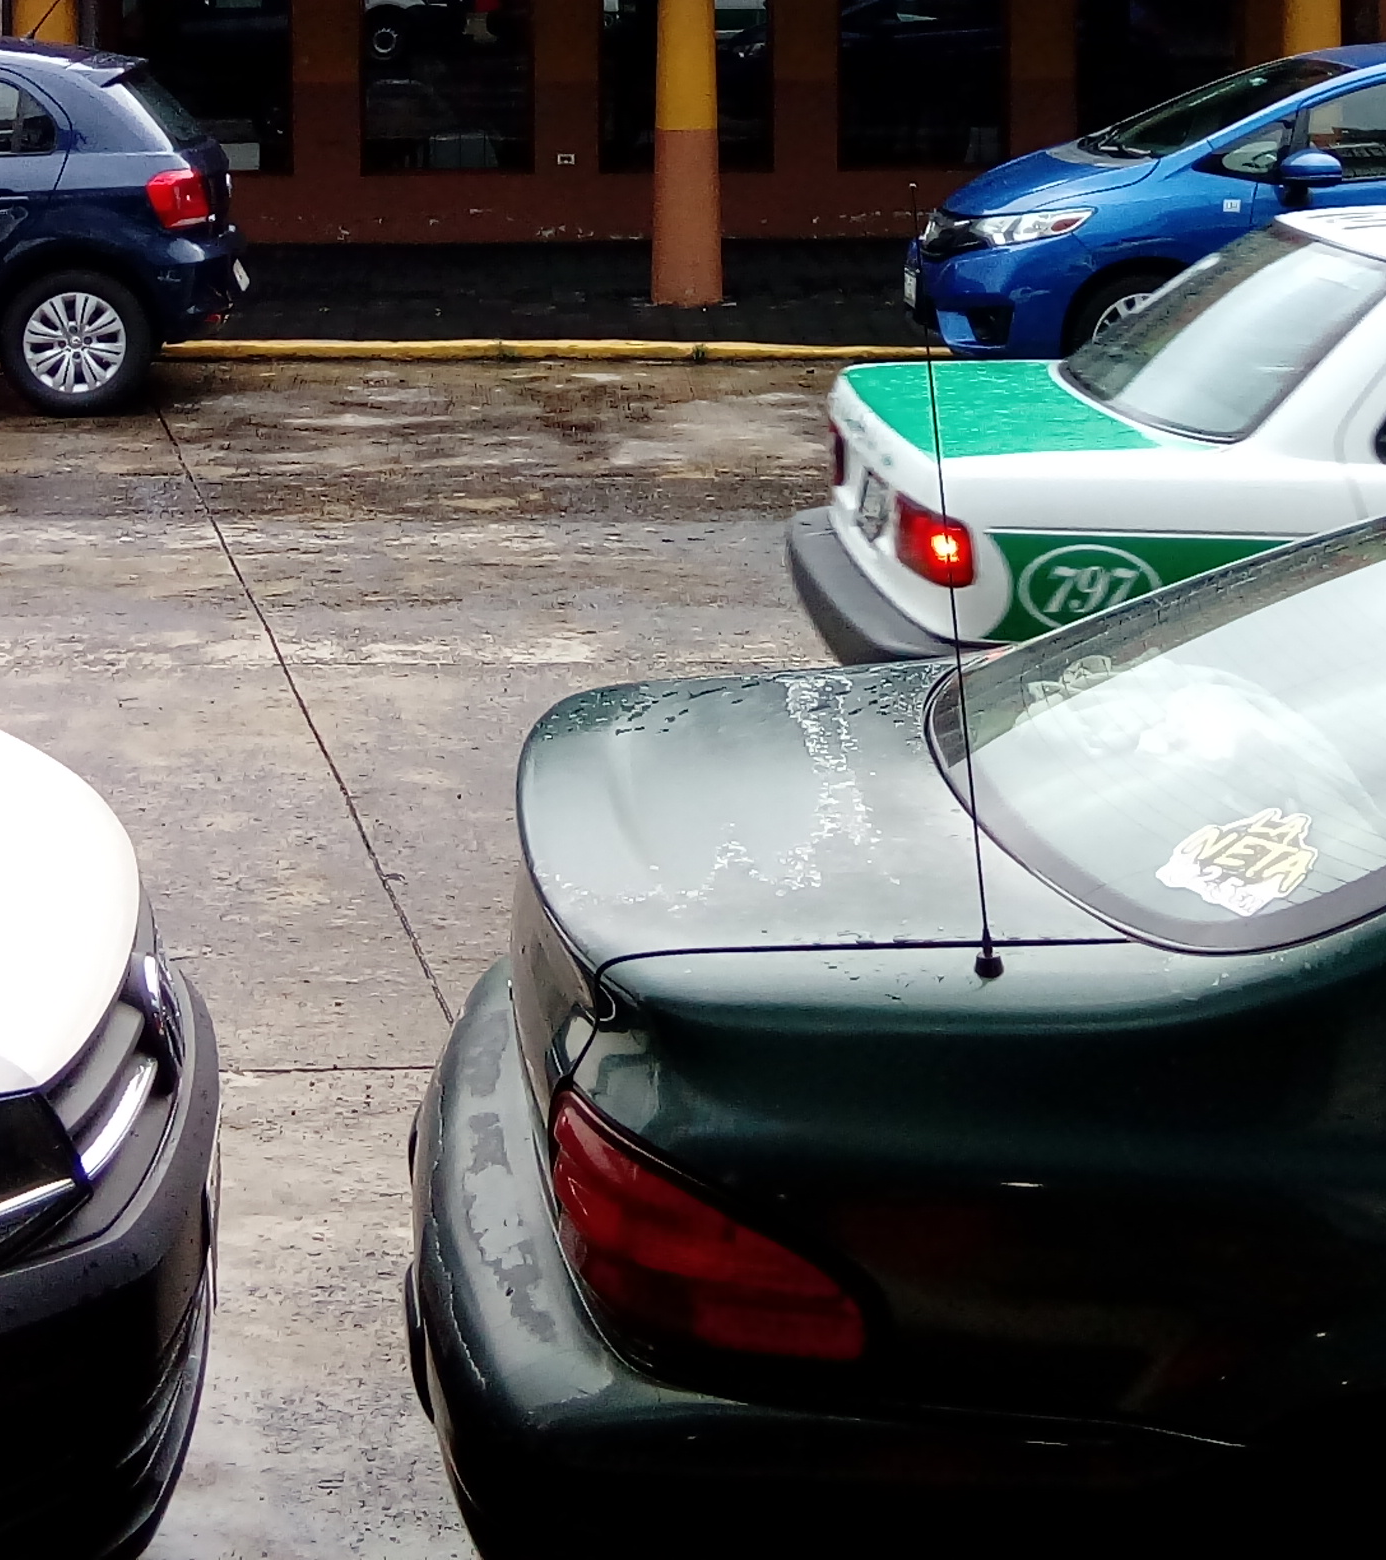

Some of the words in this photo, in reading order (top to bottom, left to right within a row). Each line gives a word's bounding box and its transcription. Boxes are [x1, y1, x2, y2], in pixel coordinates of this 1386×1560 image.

[1044, 565, 1139, 612] 797
[1247, 809, 1308, 846] LA
[1180, 825, 1314, 894] NETA
